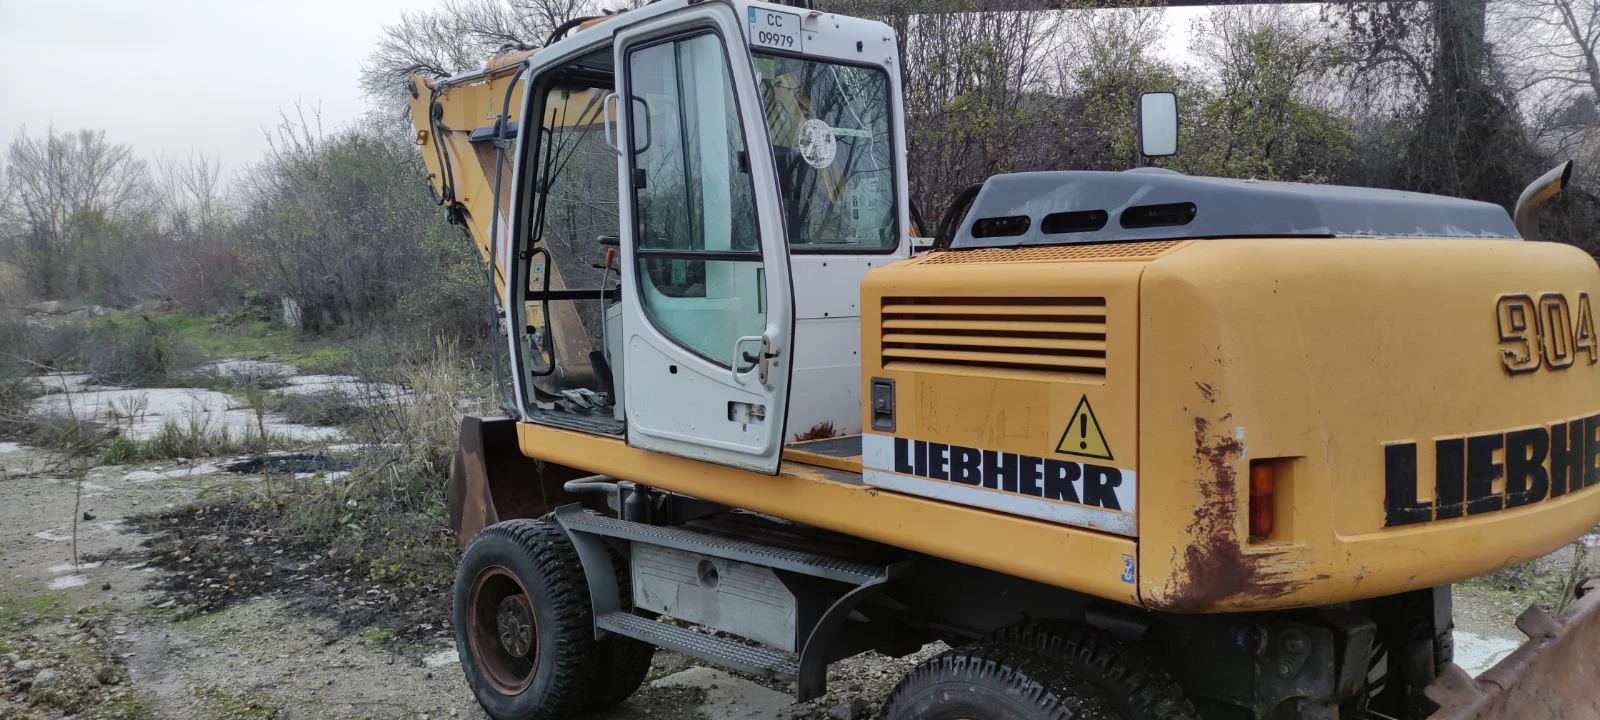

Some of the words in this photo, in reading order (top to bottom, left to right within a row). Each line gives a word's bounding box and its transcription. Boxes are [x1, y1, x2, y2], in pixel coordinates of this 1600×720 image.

[759, 31, 794, 48] 09979
[767, 13, 782, 27] CC
[1496, 292, 1598, 374] 904
[894, 437, 1122, 511] LIEBHERR
